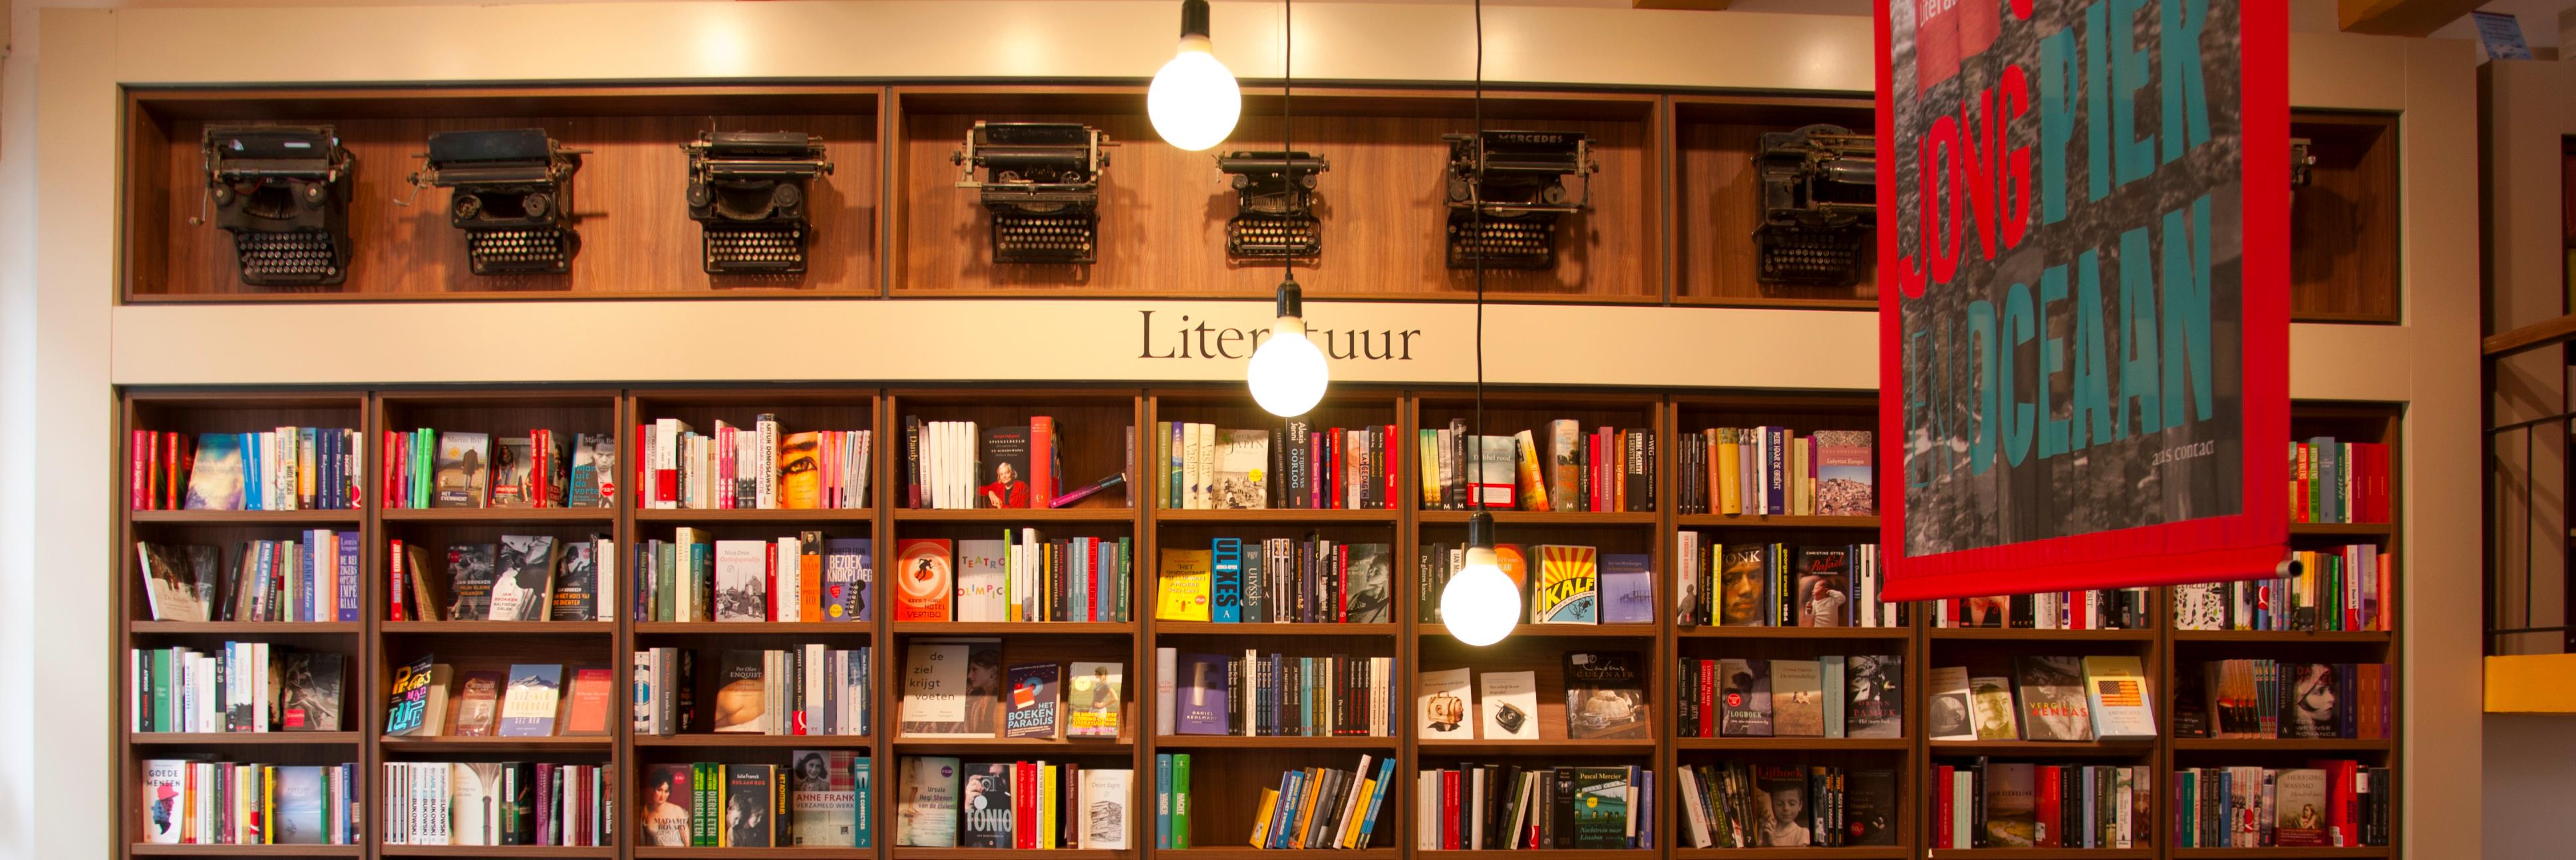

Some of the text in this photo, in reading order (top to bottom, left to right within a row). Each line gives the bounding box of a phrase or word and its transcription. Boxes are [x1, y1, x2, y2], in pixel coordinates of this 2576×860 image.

[2040, 0, 2211, 226] PIER
[1498, 134, 1563, 144] MERCEDES
[1899, 65, 2030, 299] JONG
[1138, 310, 1422, 360] Literuur
[1911, 195, 2213, 489] EN OCEAAN
[1298, 423, 1307, 444] Alexis
[909, 436, 917, 462] Dandy
[1225, 440, 1263, 455] JAPIN
[2174, 440, 2215, 461] contact
[1202, 444, 1211, 477] Vaslav
[341, 555, 357, 565] DE REI
[830, 555, 862, 569] BEZOEK
[962, 555, 1005, 568] TEATRO
[340, 566, 357, 575] ZIGERS
[827, 569, 872, 582] KNOKPLOEG
[341, 585, 357, 597] IMPE
[1248, 568, 1257, 607] ULYSSES
[806, 596, 816, 605] ECO
[1545, 578, 1595, 612] KALF
[340, 598, 357, 609] RIAAL
[930, 652, 943, 661] de
[914, 665, 933, 674] ziel
[909, 678, 940, 690] krijgt
[915, 692, 955, 701] voeten
[1039, 702, 1054, 710] HET
[2032, 708, 2088, 717] AENEAS
[1008, 709, 1054, 722] BOEKEN
[1853, 709, 1895, 718] PAMUK
[1008, 718, 1053, 730] PARADIJS
[149, 769, 178, 778] GOEDE
[797, 793, 854, 802] ANNE FRANK
[708, 791, 717, 837] DIEREN ETEN
[965, 809, 1012, 832] TONIO
